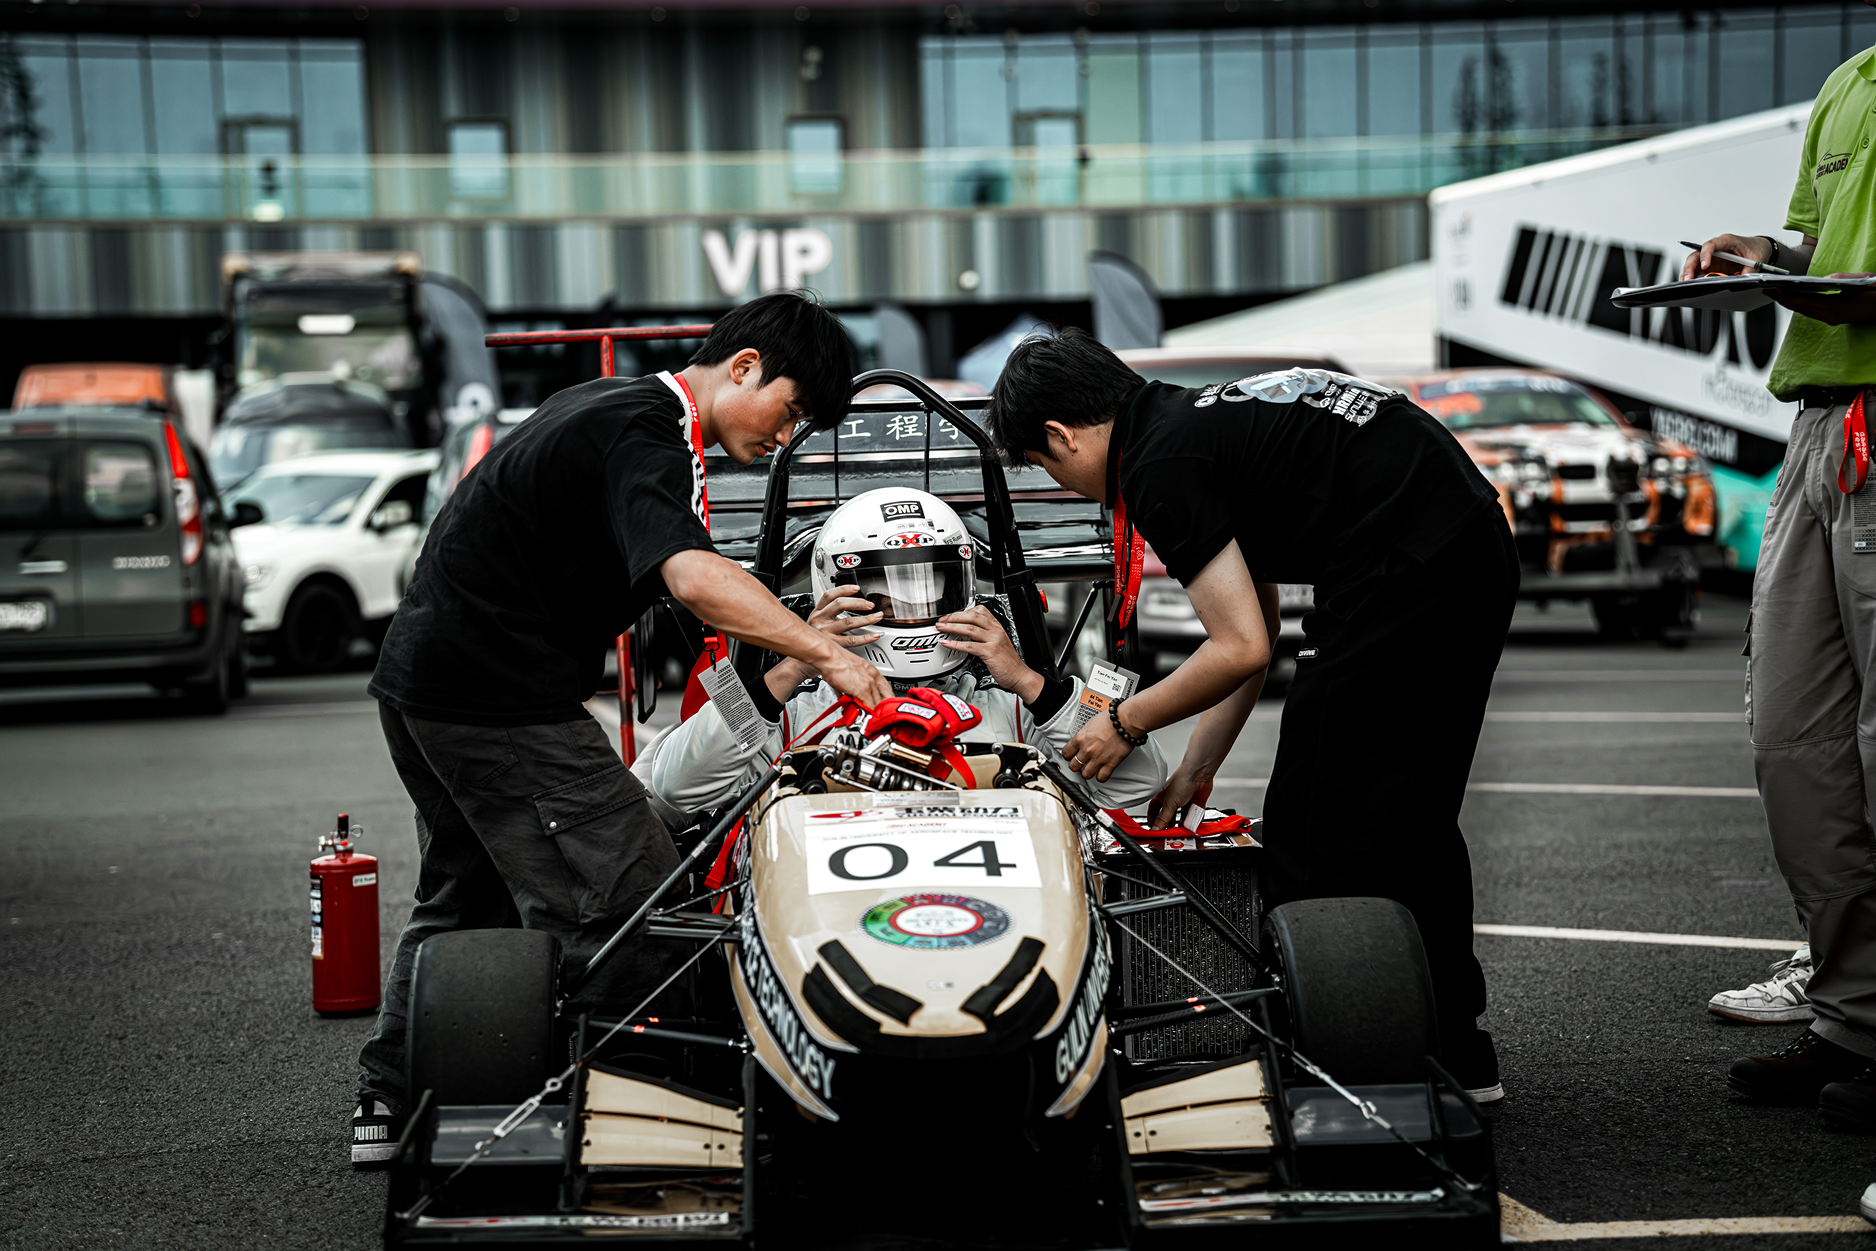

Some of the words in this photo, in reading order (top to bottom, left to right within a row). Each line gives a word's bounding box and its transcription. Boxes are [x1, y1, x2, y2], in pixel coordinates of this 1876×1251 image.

[701, 228, 833, 298] VIP
[885, 504, 920, 516] OMP
[354, 1125, 388, 1141] PUMA
